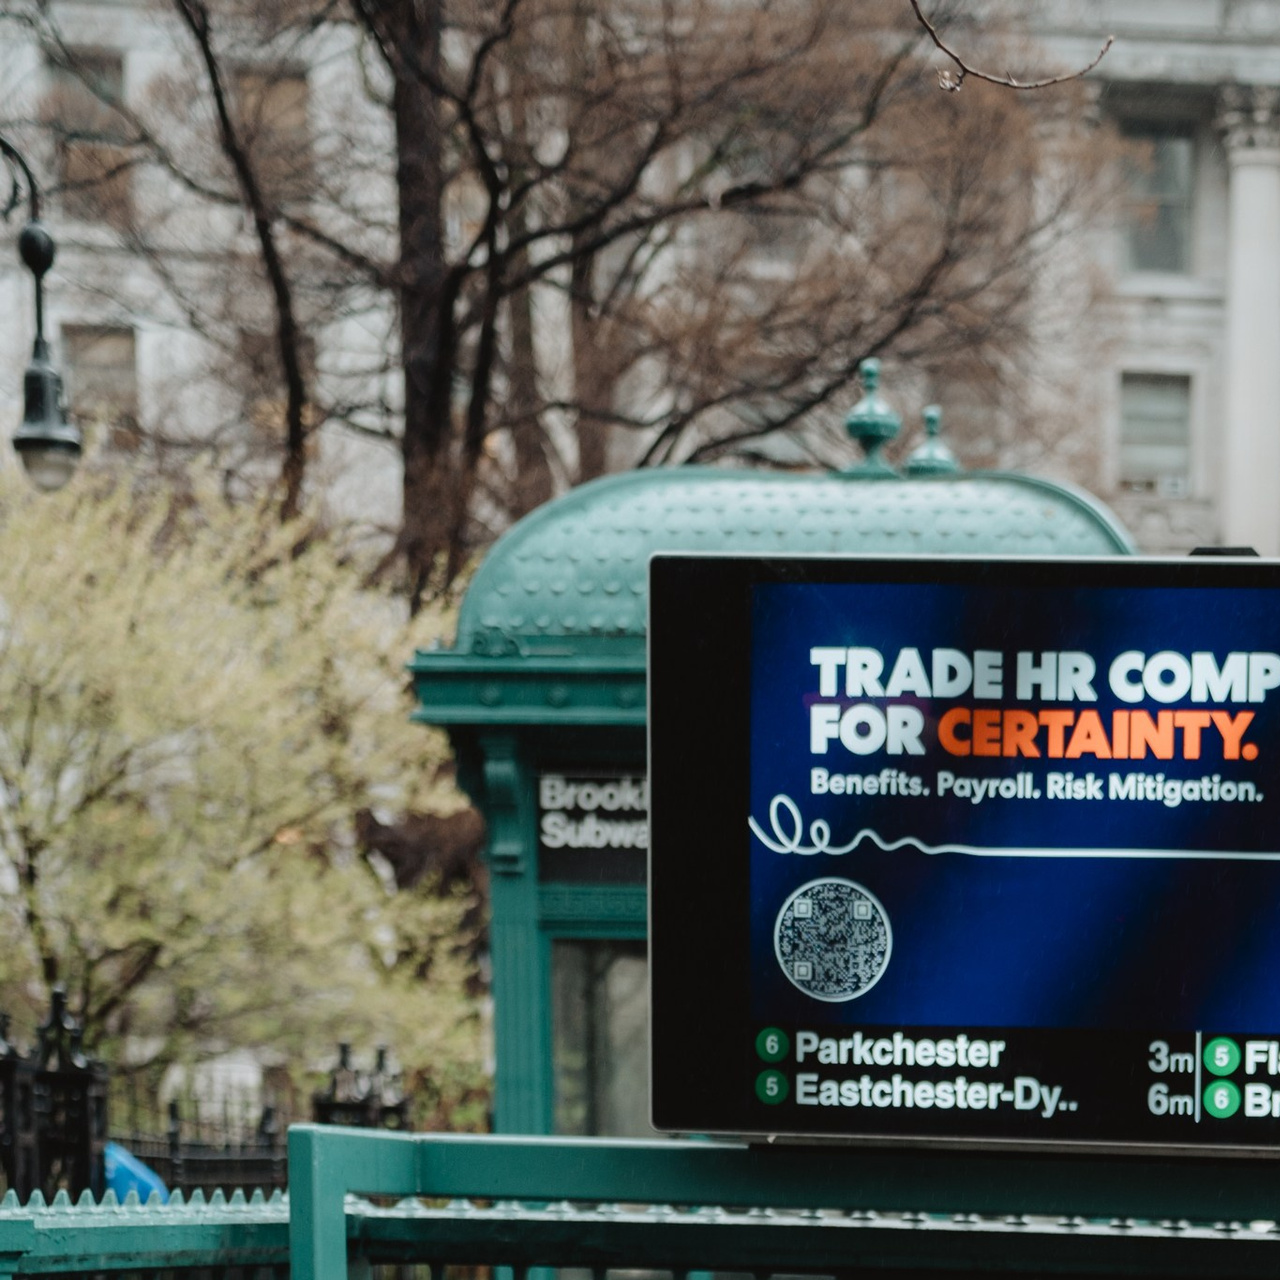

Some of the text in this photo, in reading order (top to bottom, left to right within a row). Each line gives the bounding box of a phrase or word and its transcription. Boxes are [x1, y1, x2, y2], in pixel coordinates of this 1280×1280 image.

[810, 647, 1002, 697] TRADE
[1016, 651, 1097, 702] HR
[810, 704, 1259, 761] FOR CERTAINTY.
[810, 767, 1263, 808] Benefits. Payroll. Risk Mitigation.
[764, 1032, 1194, 1074] 6 Parkchester 3m
[1214, 1045, 1230, 1067] 5
[764, 1074, 1194, 1118] 5 Eastchester-Dy.. 6m
[1213, 1088, 1230, 1110] 6
